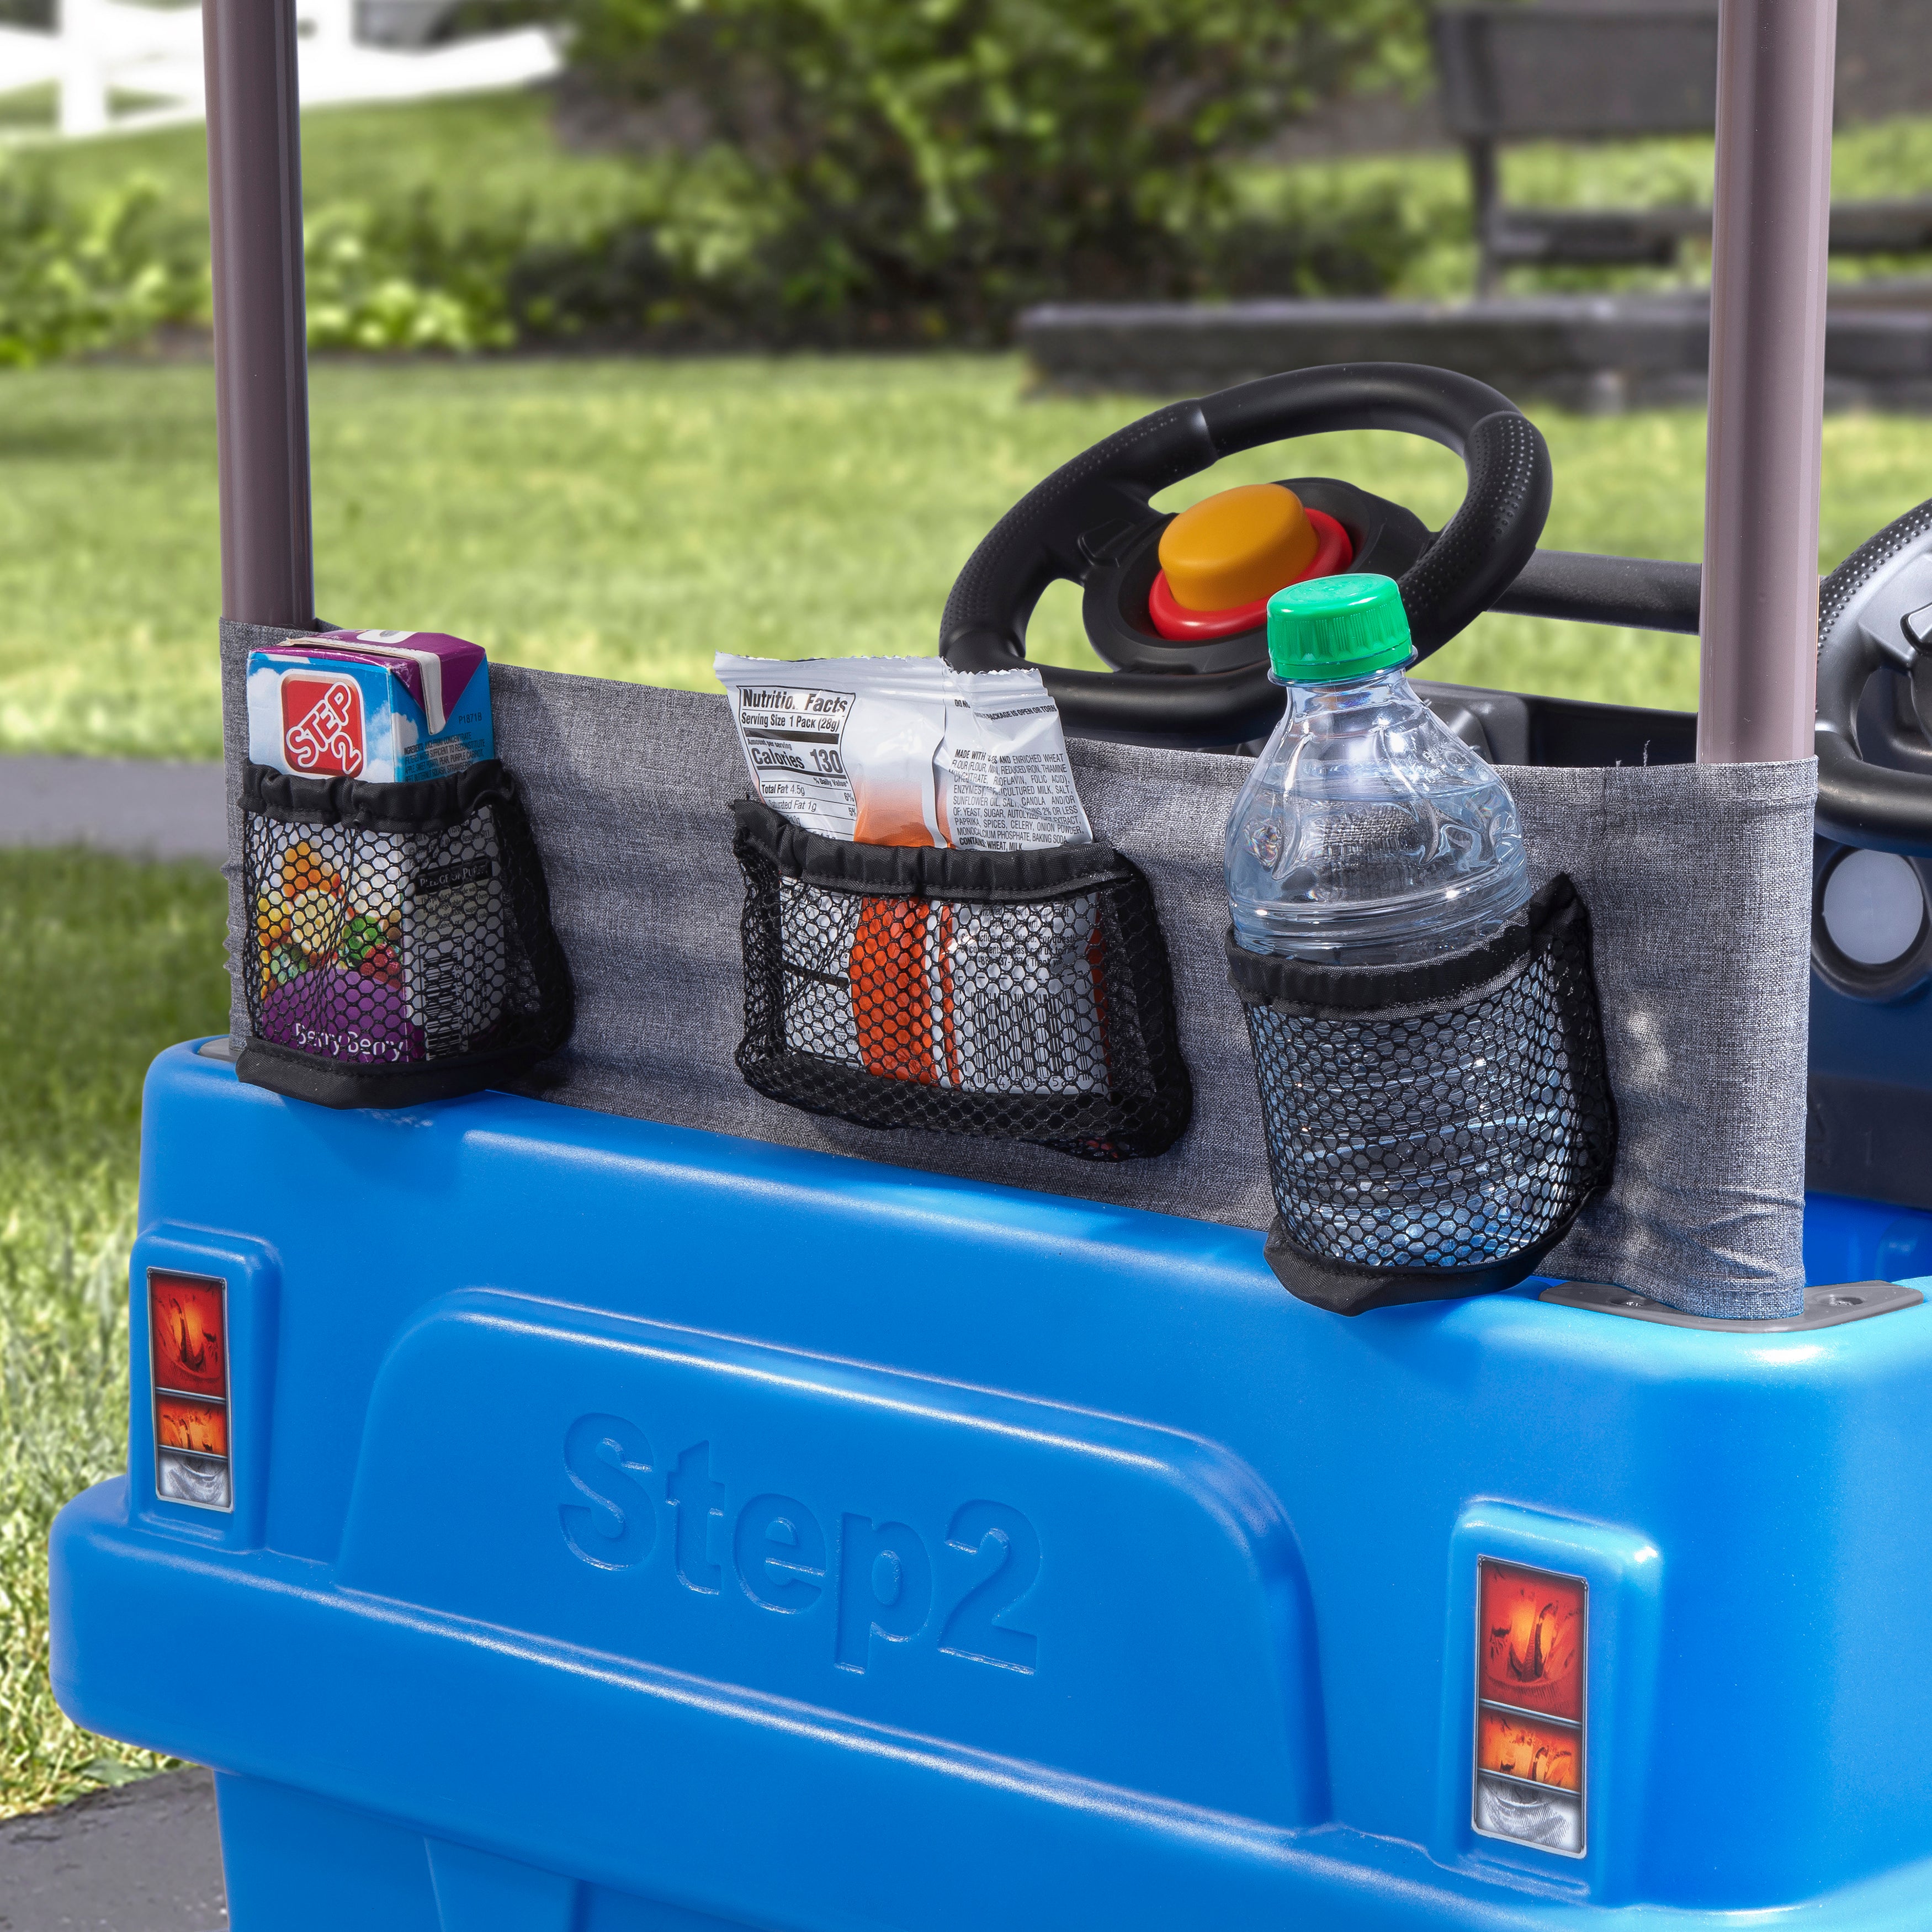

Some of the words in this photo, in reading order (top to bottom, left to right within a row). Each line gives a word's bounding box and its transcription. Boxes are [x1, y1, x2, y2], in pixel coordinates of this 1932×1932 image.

[743, 689, 798, 710] Nutritio
[804, 693, 848, 713] Facts
[1041, 704, 1057, 713] TORN
[286, 682, 351, 767] STEP
[741, 712, 768, 728] Serving
[770, 714, 785, 726] Size
[789, 715, 793, 726] 1
[818, 718, 840, 732] (28g)
[331, 732, 361, 774] 2
[775, 742, 793, 751] serving
[751, 748, 805, 769] Calories
[809, 749, 843, 773] 130
[954, 749, 970, 758] MADE
[972, 751, 986, 761] WITH
[999, 756, 1011, 764] AND
[1012, 754, 1042, 764] ENRICHED
[1043, 753, 1064, 762] WHEAT
[951, 759, 968, 769] FLOUR
[1001, 765, 1026, 775] REDUCED
[1026, 765, 1042, 774] IRON,
[1041, 764, 1067, 773] THIAMINE
[820, 778, 832, 787] Daily
[1031, 774, 1047, 784] FOLIC
[1052, 774, 1070, 784] ACID),
[761, 784, 777, 794] Total
[777, 784, 789, 794] Fat
[790, 785, 805, 796] 4.5g
[1037, 785, 1053, 795] MILK,
[1055, 785, 1073, 794] SALT,
[793, 800, 806, 810] Fat
[808, 801, 817, 812] 1g
[953, 795, 988, 806] SUNFLOWER
[1021, 797, 1046, 806] CANOLA
[1052, 795, 1075, 805] AND/OR
[963, 808, 982, 818] YEAST,
[984, 808, 1006, 819] SUGAR,
[1053, 816, 1082, 825] EXTRACT,
[1042, 807, 1052, 815] 2%
[1052, 806, 1061, 815] OR
[1062, 805, 1078, 815] LESS
[954, 818, 981, 827] PAPRIKA,
[983, 819, 1007, 830] SPICES,
[1010, 820, 1034, 831] CELERY,
[1037, 822, 1055, 832] ONION
[1057, 824, 1084, 835] POWDER,
[997, 830, 1031, 842] PHOSPHATE,
[1032, 832, 1052, 843] BAKING
[959, 837, 987, 848] CONTAINS:
[986, 840, 1008, 851] WHEAT,
[558, 1411, 1042, 1676] Step2
